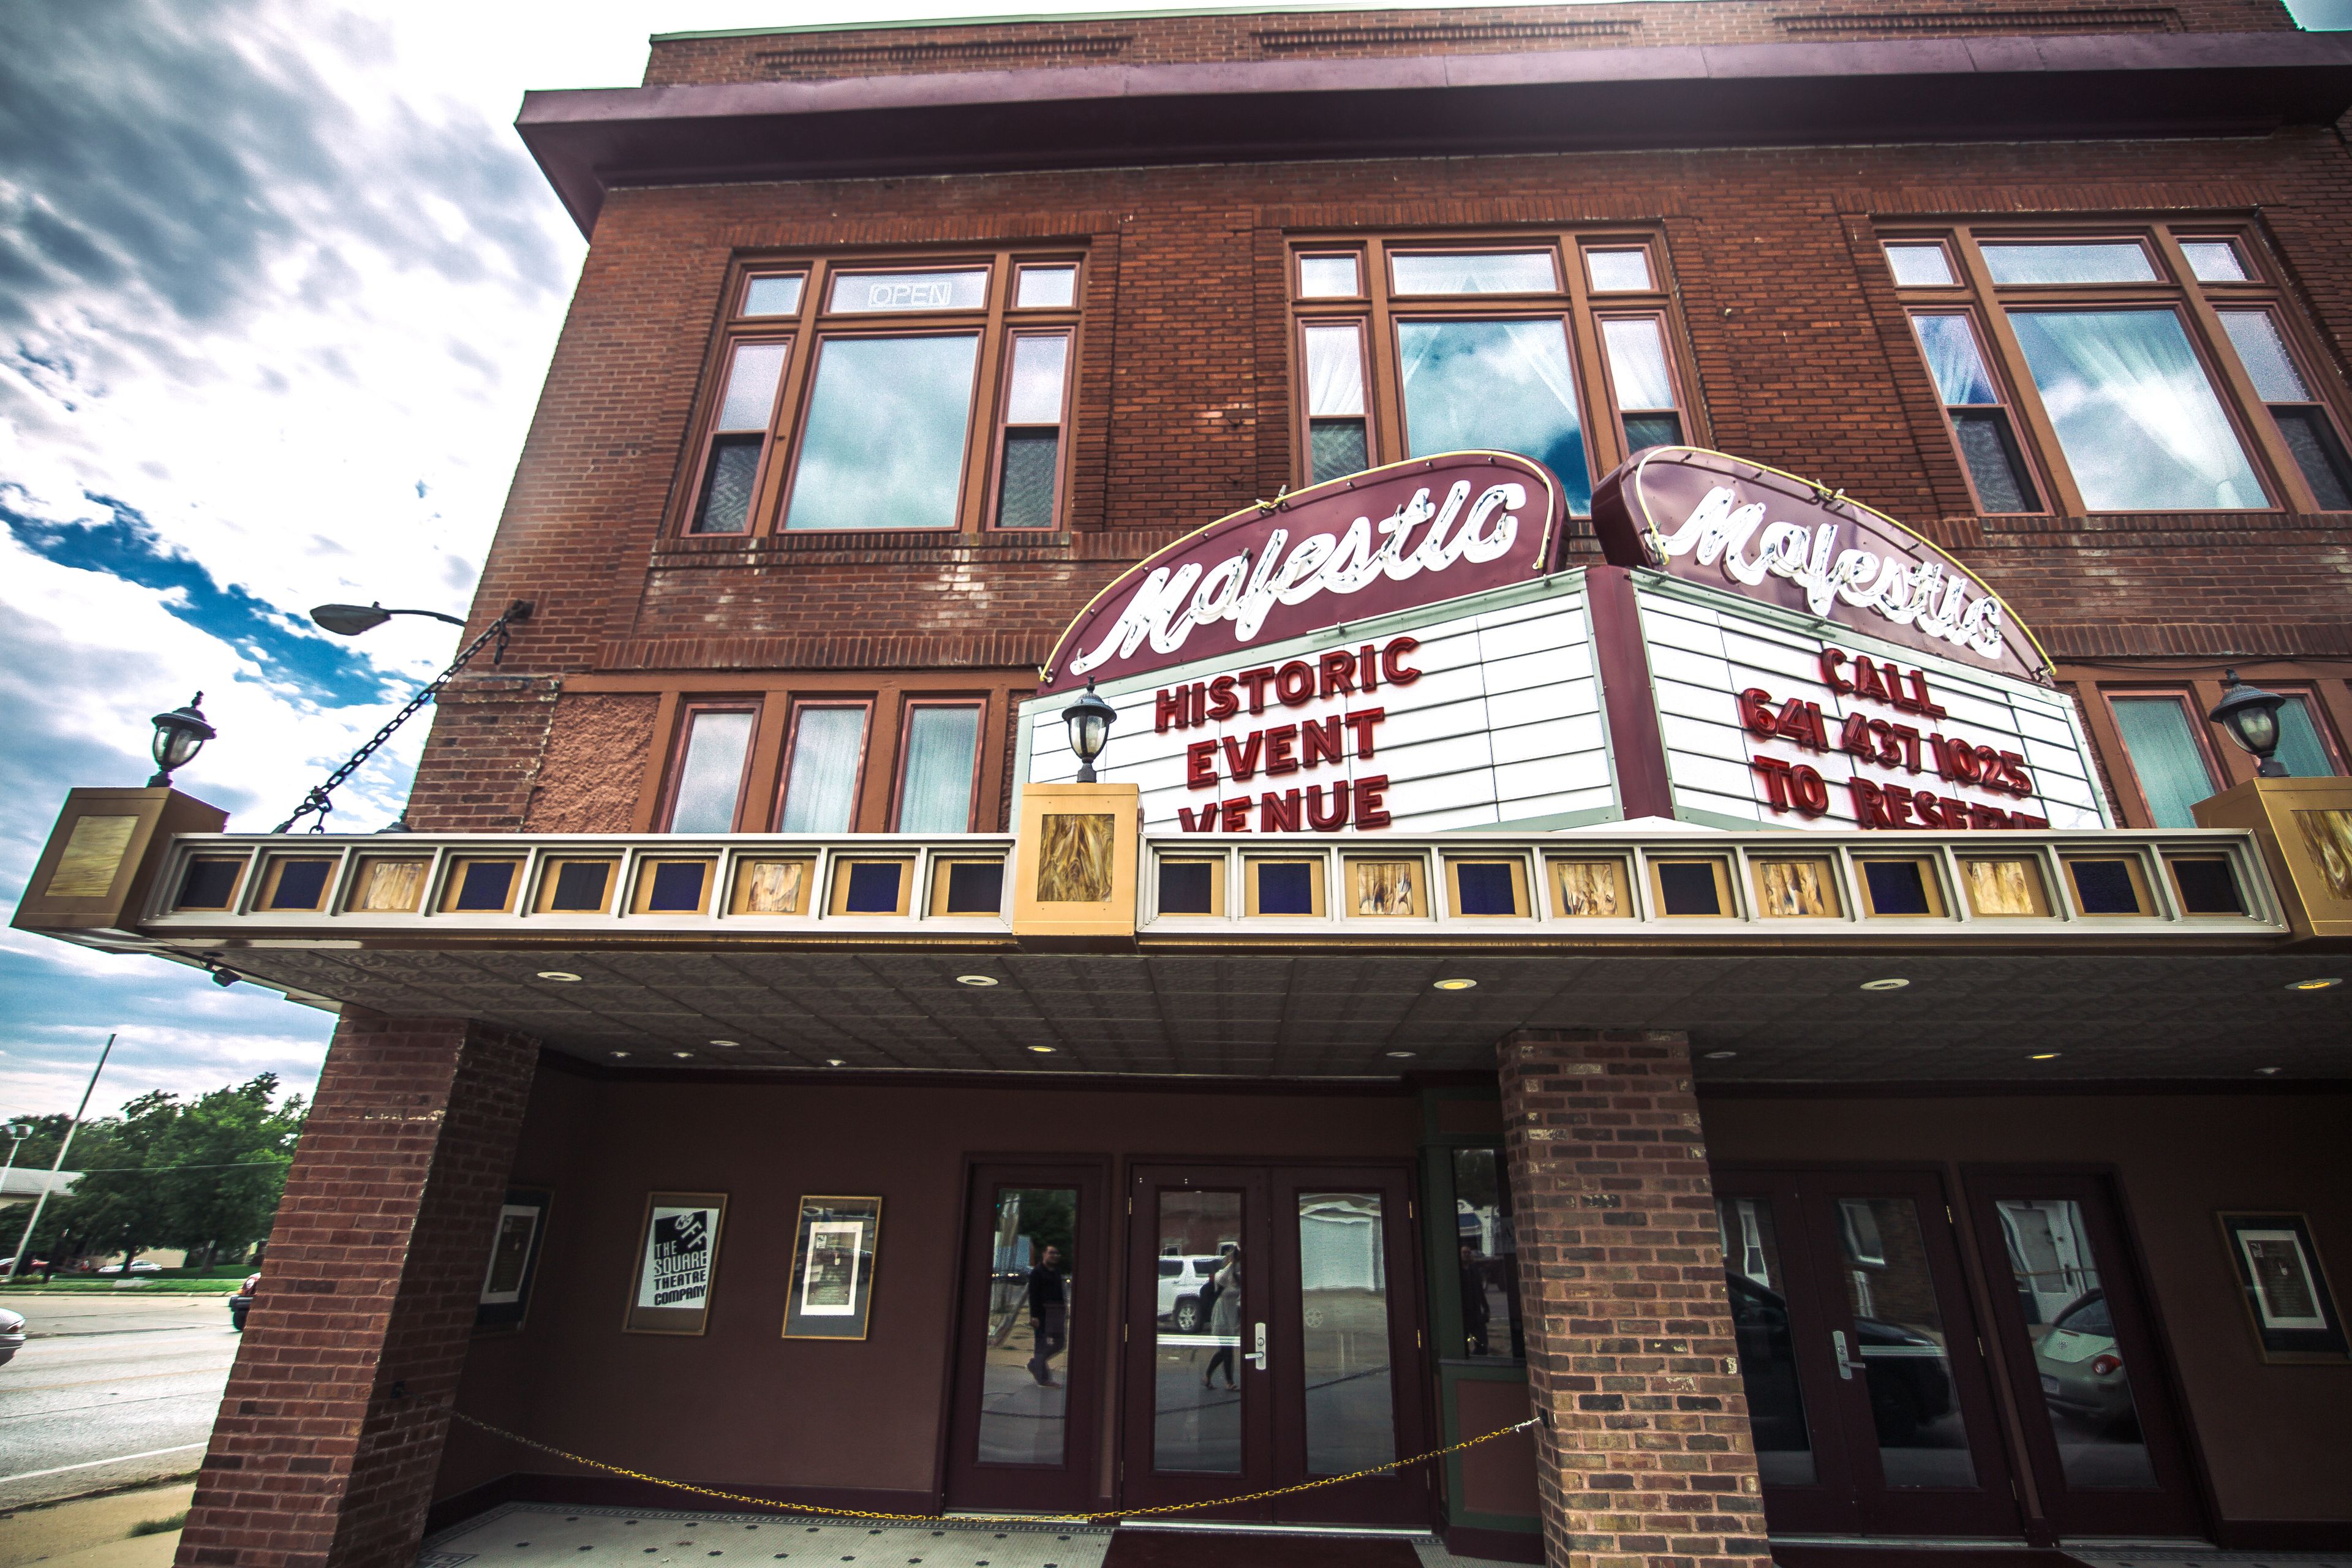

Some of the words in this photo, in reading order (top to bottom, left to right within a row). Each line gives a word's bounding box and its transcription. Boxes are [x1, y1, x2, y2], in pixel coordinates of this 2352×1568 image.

[872, 282, 950, 306] OPEN
[1069, 480, 1526, 676] Majestic
[1644, 486, 2002, 659] Majestic
[1155, 637, 1422, 733] HISTORIC
[1820, 647, 1948, 720] CALL
[1186, 706, 1385, 790] EVENT
[1742, 687, 1830, 754] 641
[1842, 712, 1922, 775] 437
[1931, 733, 2034, 798] 1025
[1178, 774, 1391, 833] VENUE
[1754, 755, 1829, 819] TO
[1849, 777, 2051, 829] RESER
[654, 1251, 707, 1275] SQUARE
[654, 1270, 706, 1290] THEATRE
[655, 1240, 677, 1258] THE
[654, 1284, 706, 1305] COMPANY
